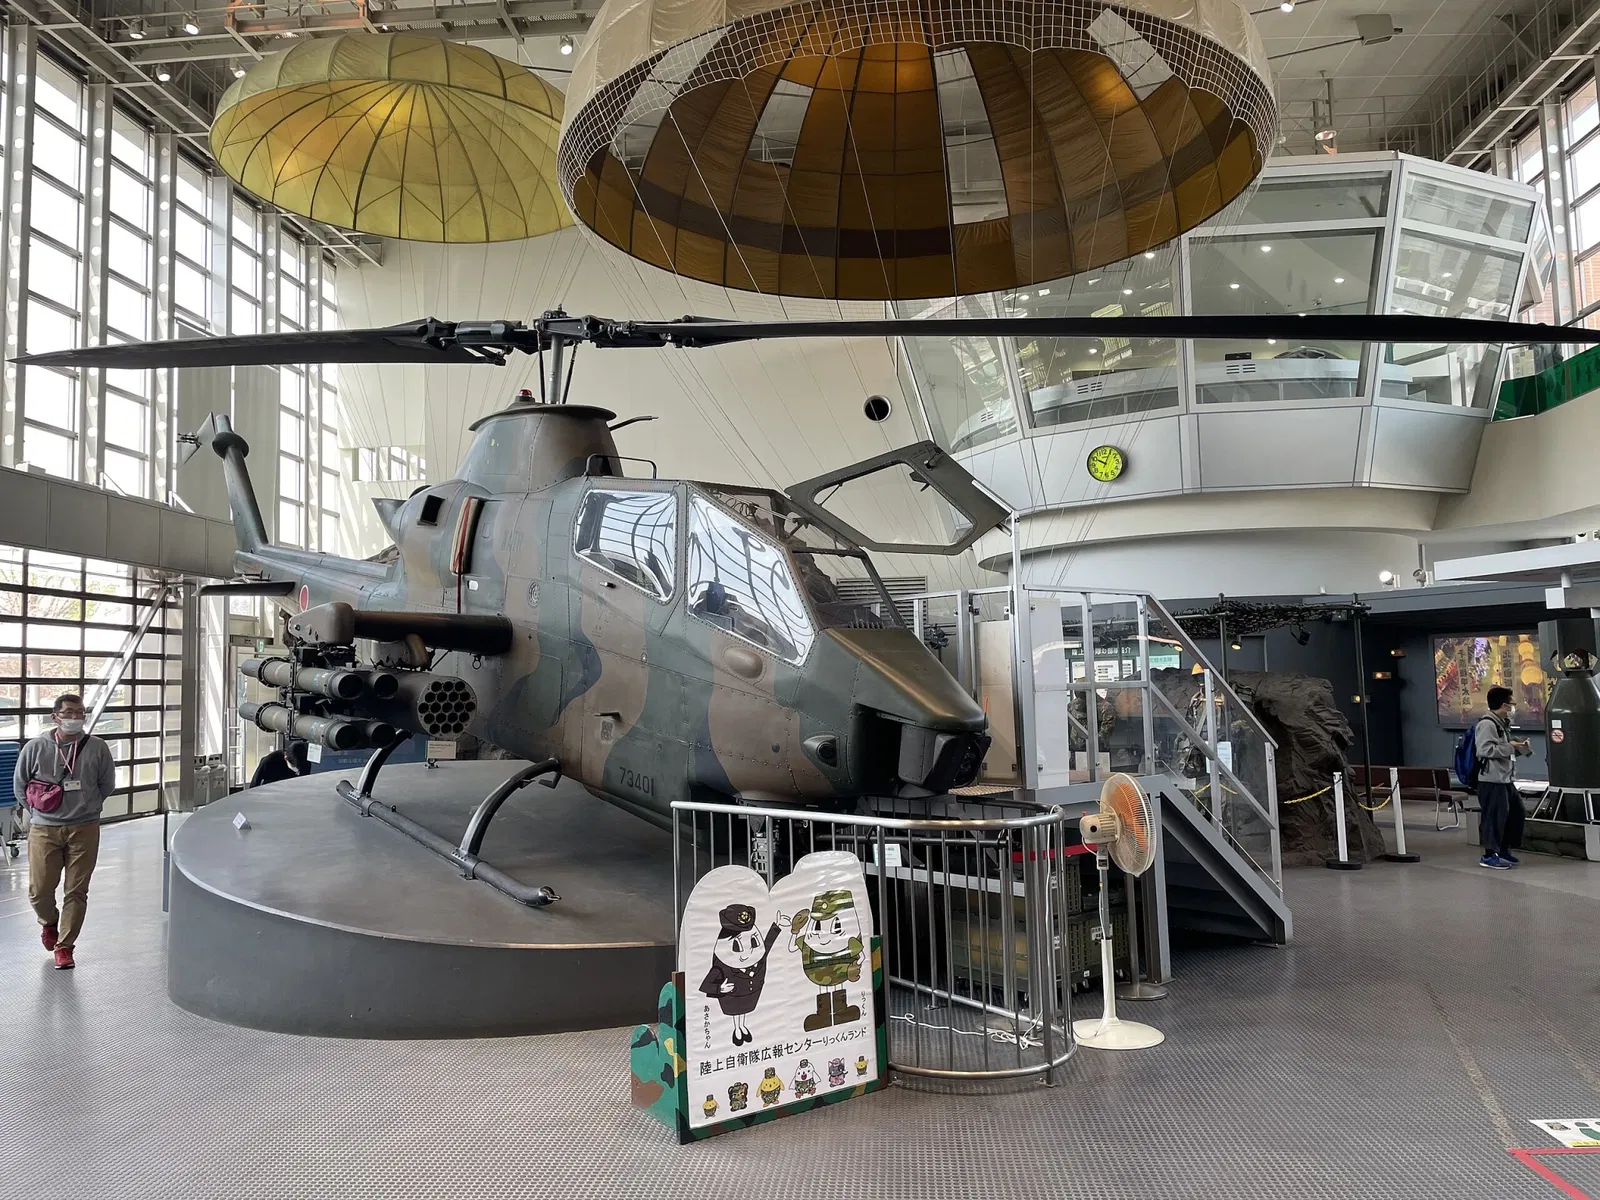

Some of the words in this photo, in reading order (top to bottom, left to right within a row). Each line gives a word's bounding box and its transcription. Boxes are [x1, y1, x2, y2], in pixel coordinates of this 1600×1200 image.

[619, 766, 654, 797] 73401
[703, 1005, 711, 1049] あさかちゃん
[700, 1026, 867, 1077] 陸上自衛隊広報センターりっくんランド
